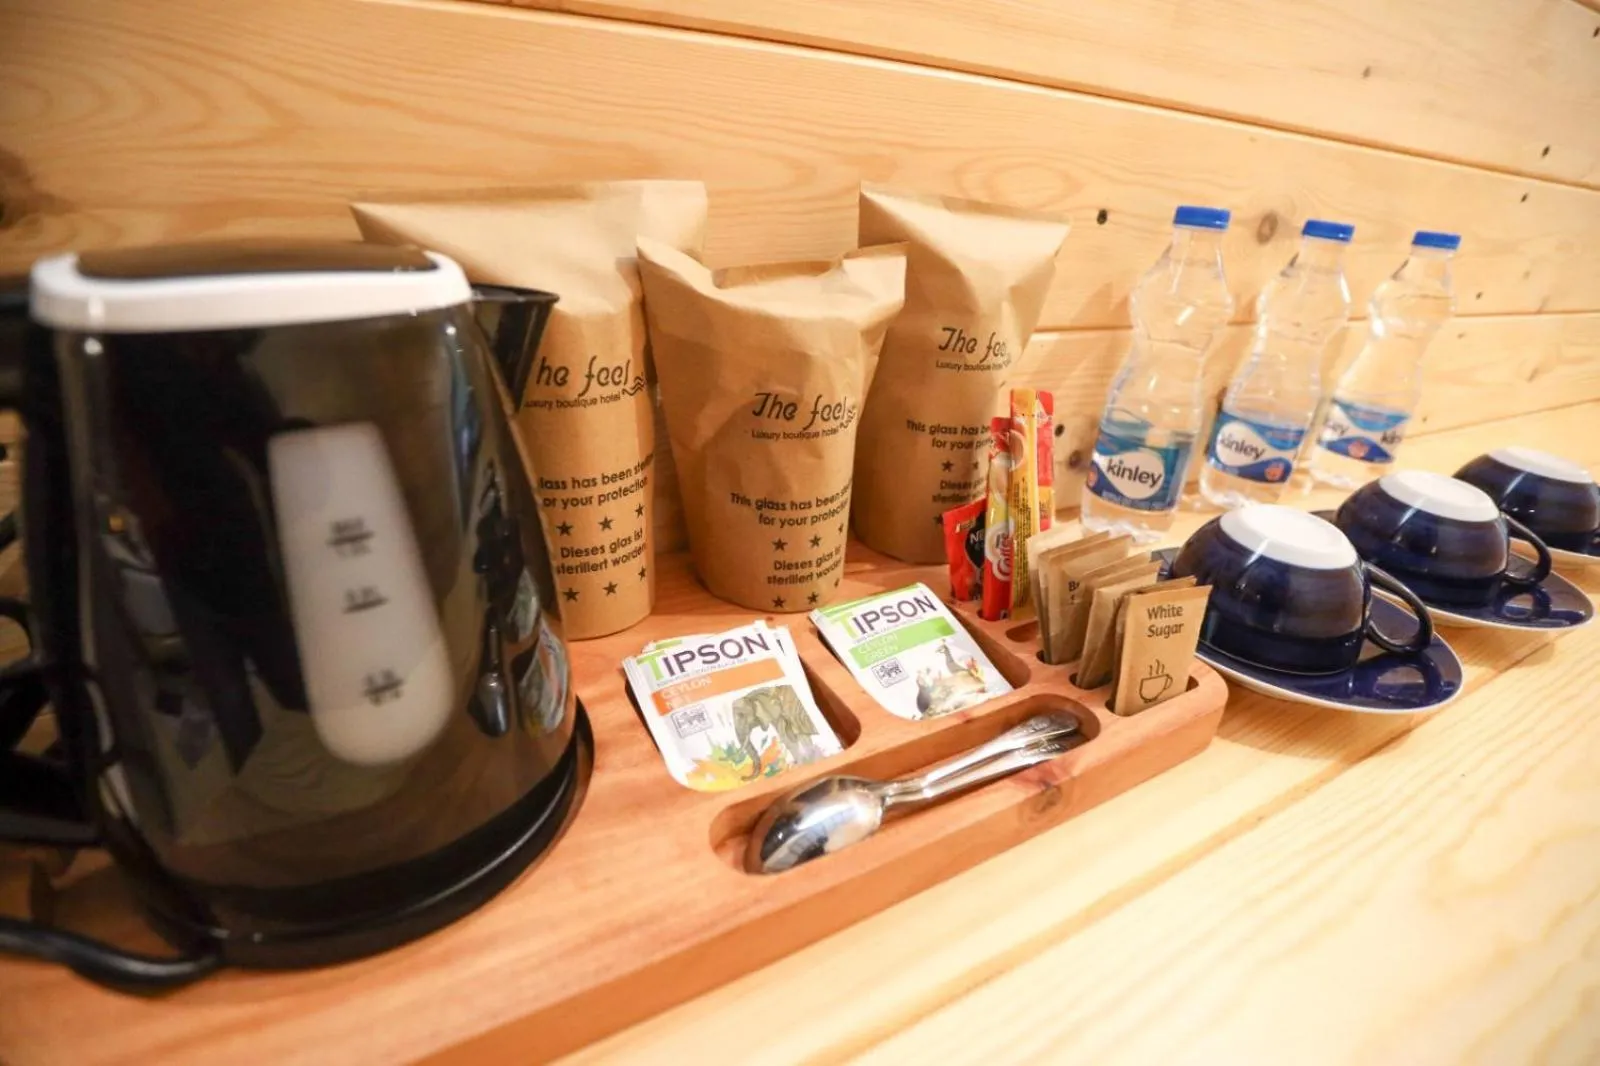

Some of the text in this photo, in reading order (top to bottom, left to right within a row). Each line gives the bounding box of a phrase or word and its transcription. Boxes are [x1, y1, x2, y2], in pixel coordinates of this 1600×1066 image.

[938, 327, 978, 354] The
[536, 355, 631, 397] he feel
[556, 396, 598, 408] boutique
[600, 391, 621, 404] hotel
[752, 392, 847, 431] The feel
[906, 419, 926, 433] This
[928, 423, 959, 436] glass
[960, 425, 979, 436] has
[931, 437, 948, 449] for
[950, 440, 974, 451] your
[540, 467, 633, 490] lass has been
[1106, 458, 1162, 489] kinley
[543, 497, 557, 508] or
[561, 494, 594, 510] your
[755, 496, 787, 511] glass
[789, 500, 813, 511] has
[758, 512, 776, 526] for
[779, 516, 808, 529] your
[560, 544, 606, 559] Dieses
[608, 535, 633, 554] glas
[773, 559, 813, 571] Dieses
[831, 594, 938, 641] TIPSON
[1147, 604, 1184, 621] White
[1147, 622, 1185, 639] Sugar
[635, 632, 770, 682] TIPSON
